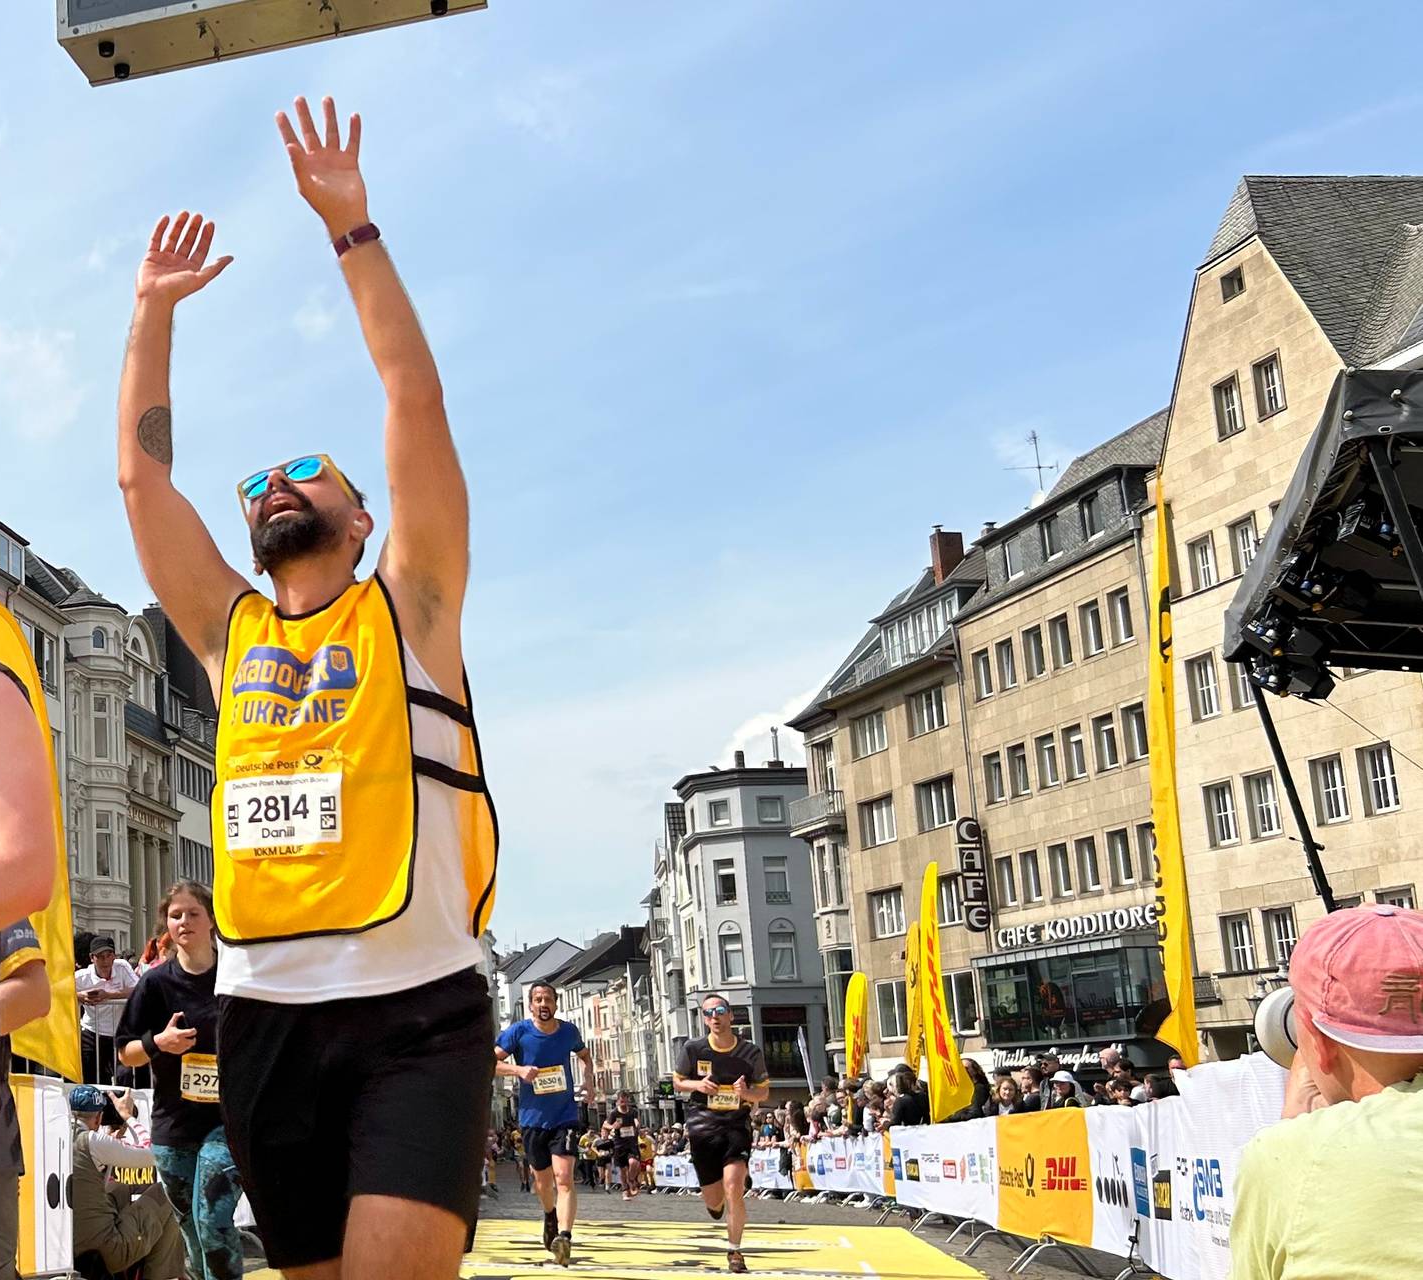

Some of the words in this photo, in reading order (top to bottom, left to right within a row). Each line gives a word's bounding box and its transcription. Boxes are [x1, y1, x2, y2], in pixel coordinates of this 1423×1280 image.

[236, 761, 275, 774] Deutsche
[276, 760, 299, 769] Post
[247, 793, 310, 823] 2814
[254, 846, 277, 857] 10KM
[279, 844, 304, 855] LAUF
[958, 820, 989, 929] CAFE
[997, 924, 1037, 948] CAFE
[1044, 903, 1157, 941] KONDITORE
[1045, 1157, 1081, 1191] DHL
